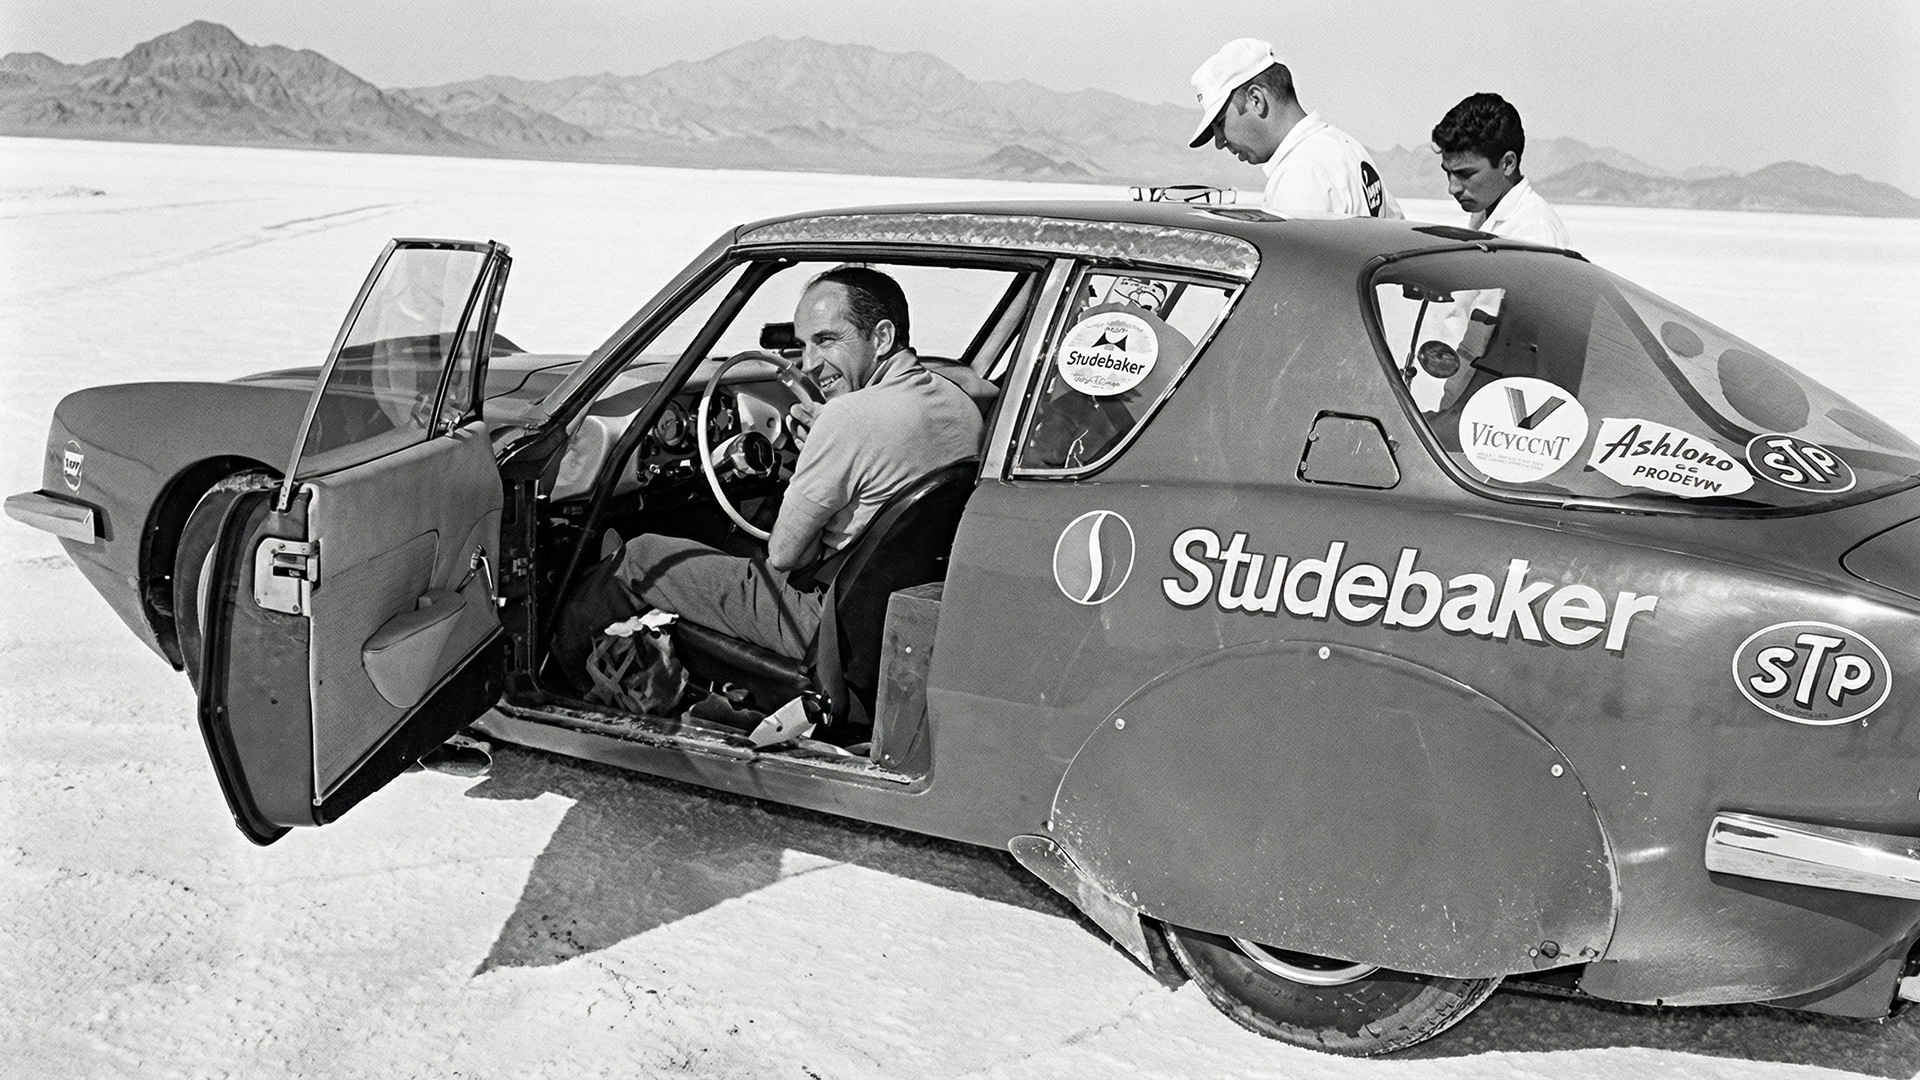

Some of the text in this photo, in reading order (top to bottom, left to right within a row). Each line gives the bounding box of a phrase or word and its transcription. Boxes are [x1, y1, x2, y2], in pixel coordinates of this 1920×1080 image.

[1066, 350, 1146, 375] Studebaker
[1763, 439, 1838, 483] STP
[1162, 527, 1660, 652] Studebaker
[1750, 632, 1873, 707] STP
